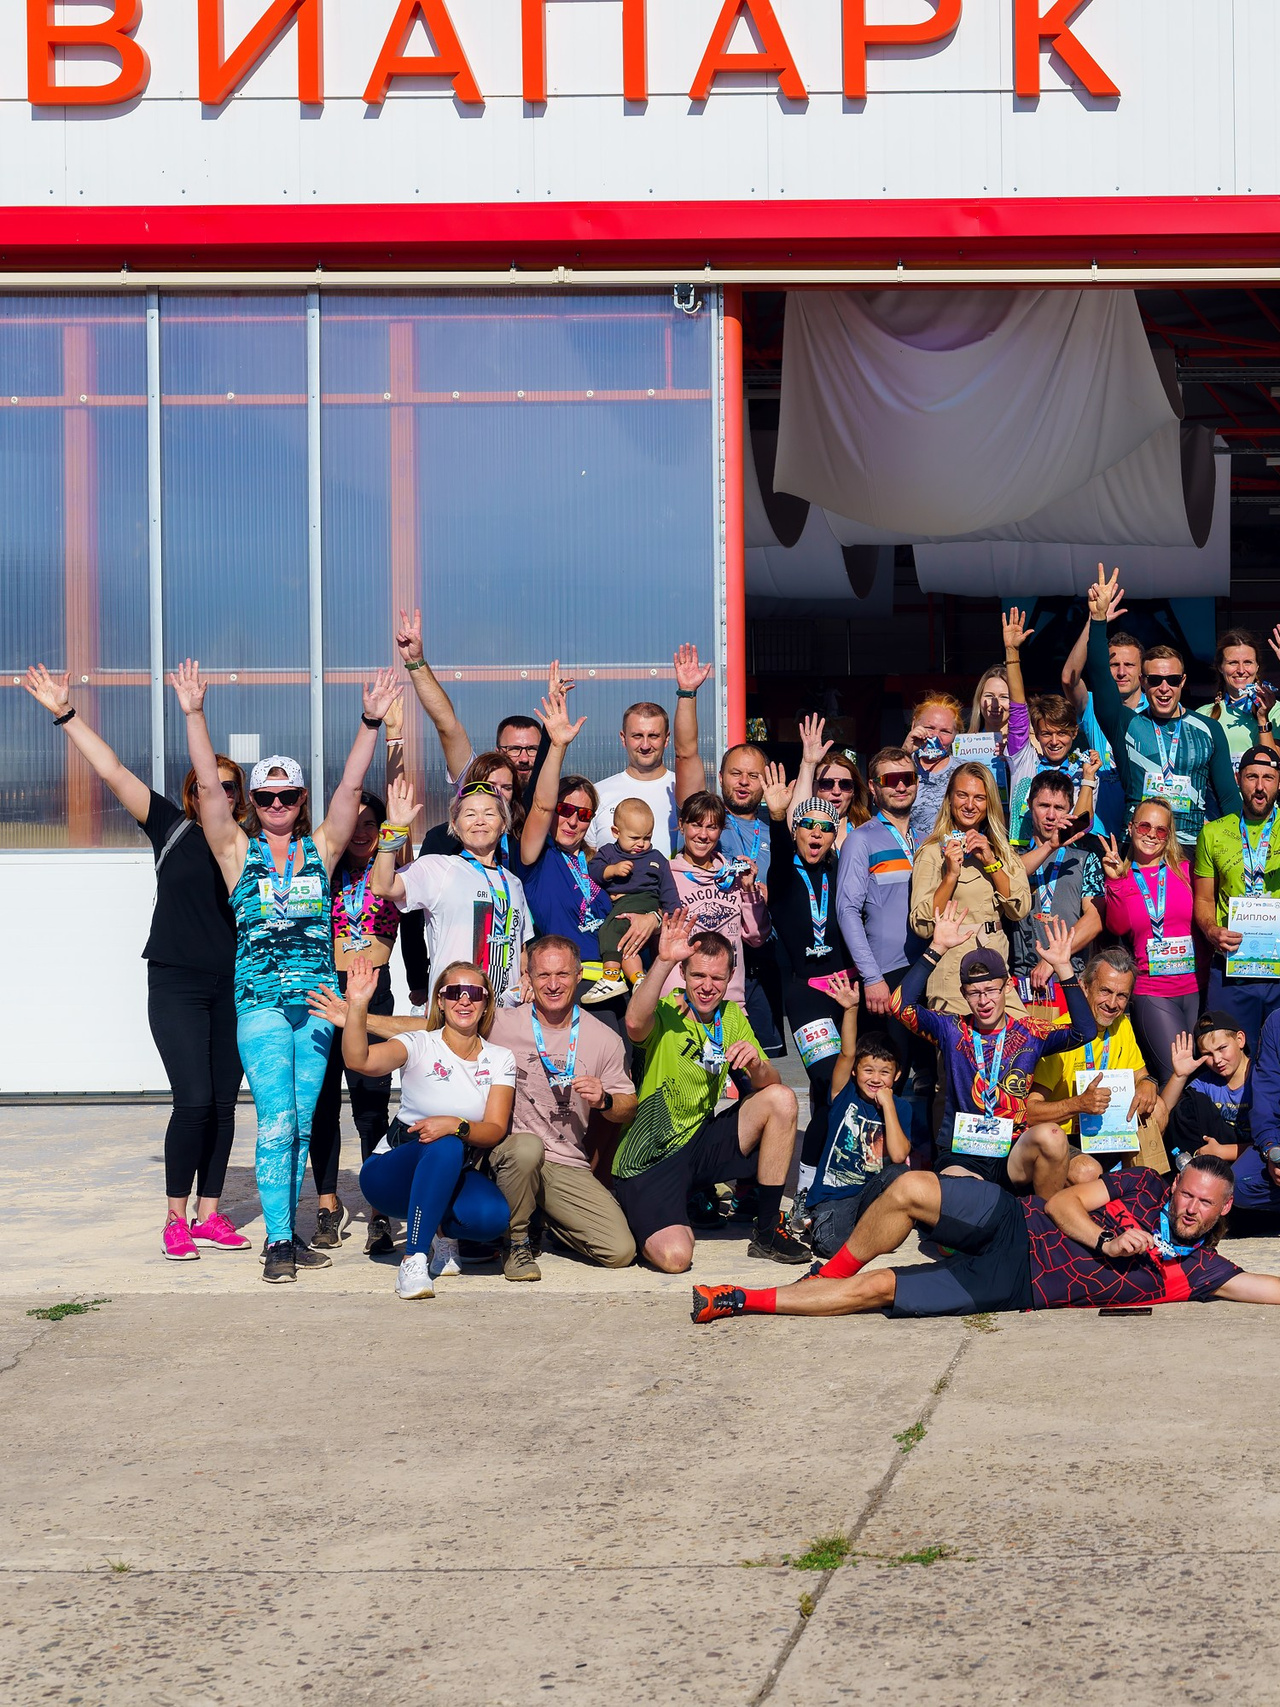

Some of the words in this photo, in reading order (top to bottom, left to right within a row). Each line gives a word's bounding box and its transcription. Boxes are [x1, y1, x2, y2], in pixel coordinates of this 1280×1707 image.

[26, 0, 1121, 107] ВИАПАРК
[1236, 913, 1277, 922] ДИПЛОМ
[805, 1028, 829, 1043] 519
